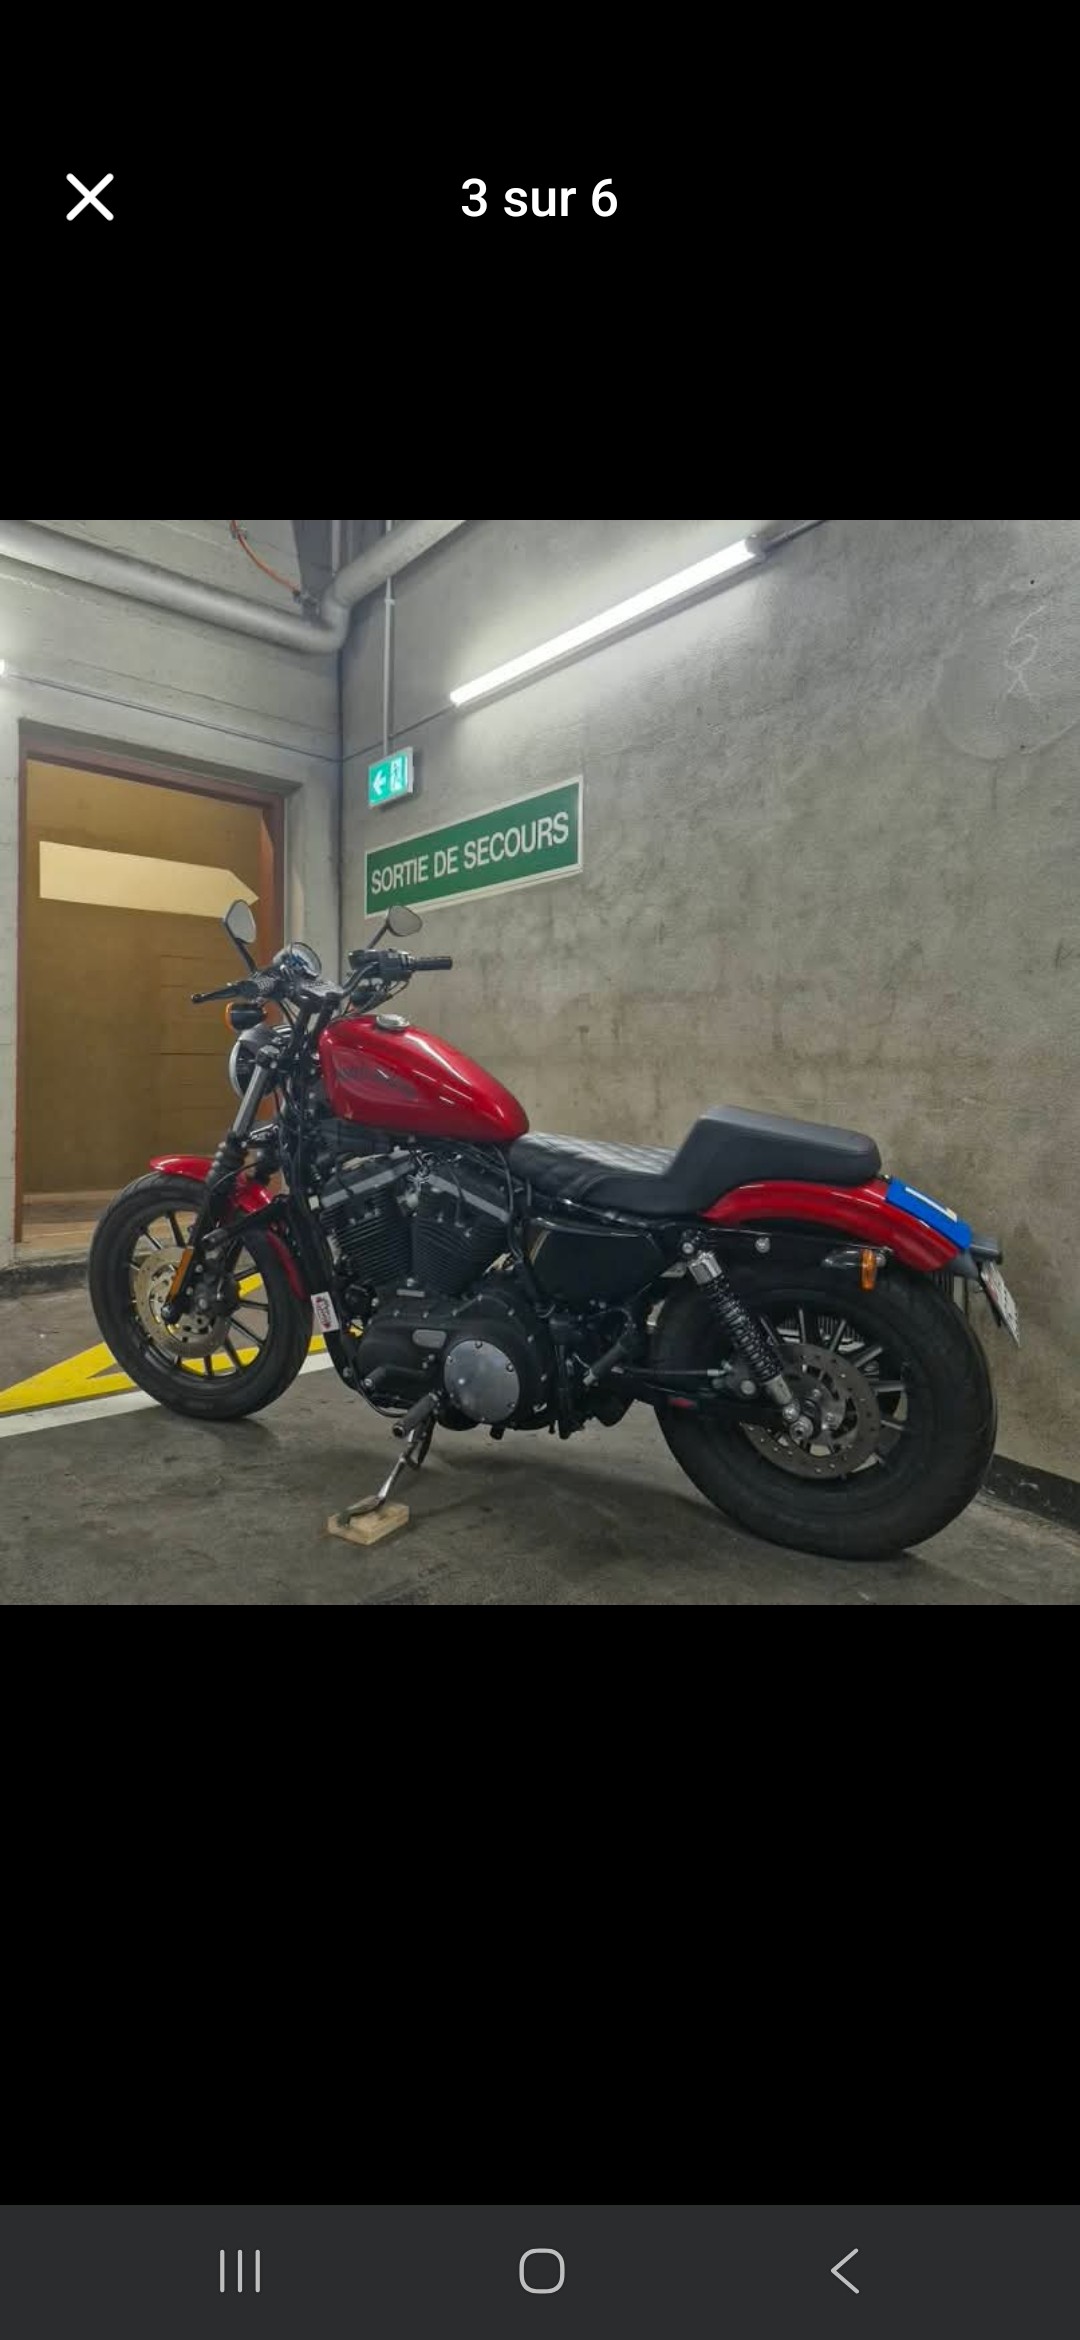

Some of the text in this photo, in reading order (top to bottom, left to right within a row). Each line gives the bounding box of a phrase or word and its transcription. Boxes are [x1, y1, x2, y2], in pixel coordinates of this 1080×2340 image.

[371, 811, 569, 895] SORTIE DE SECOURS
